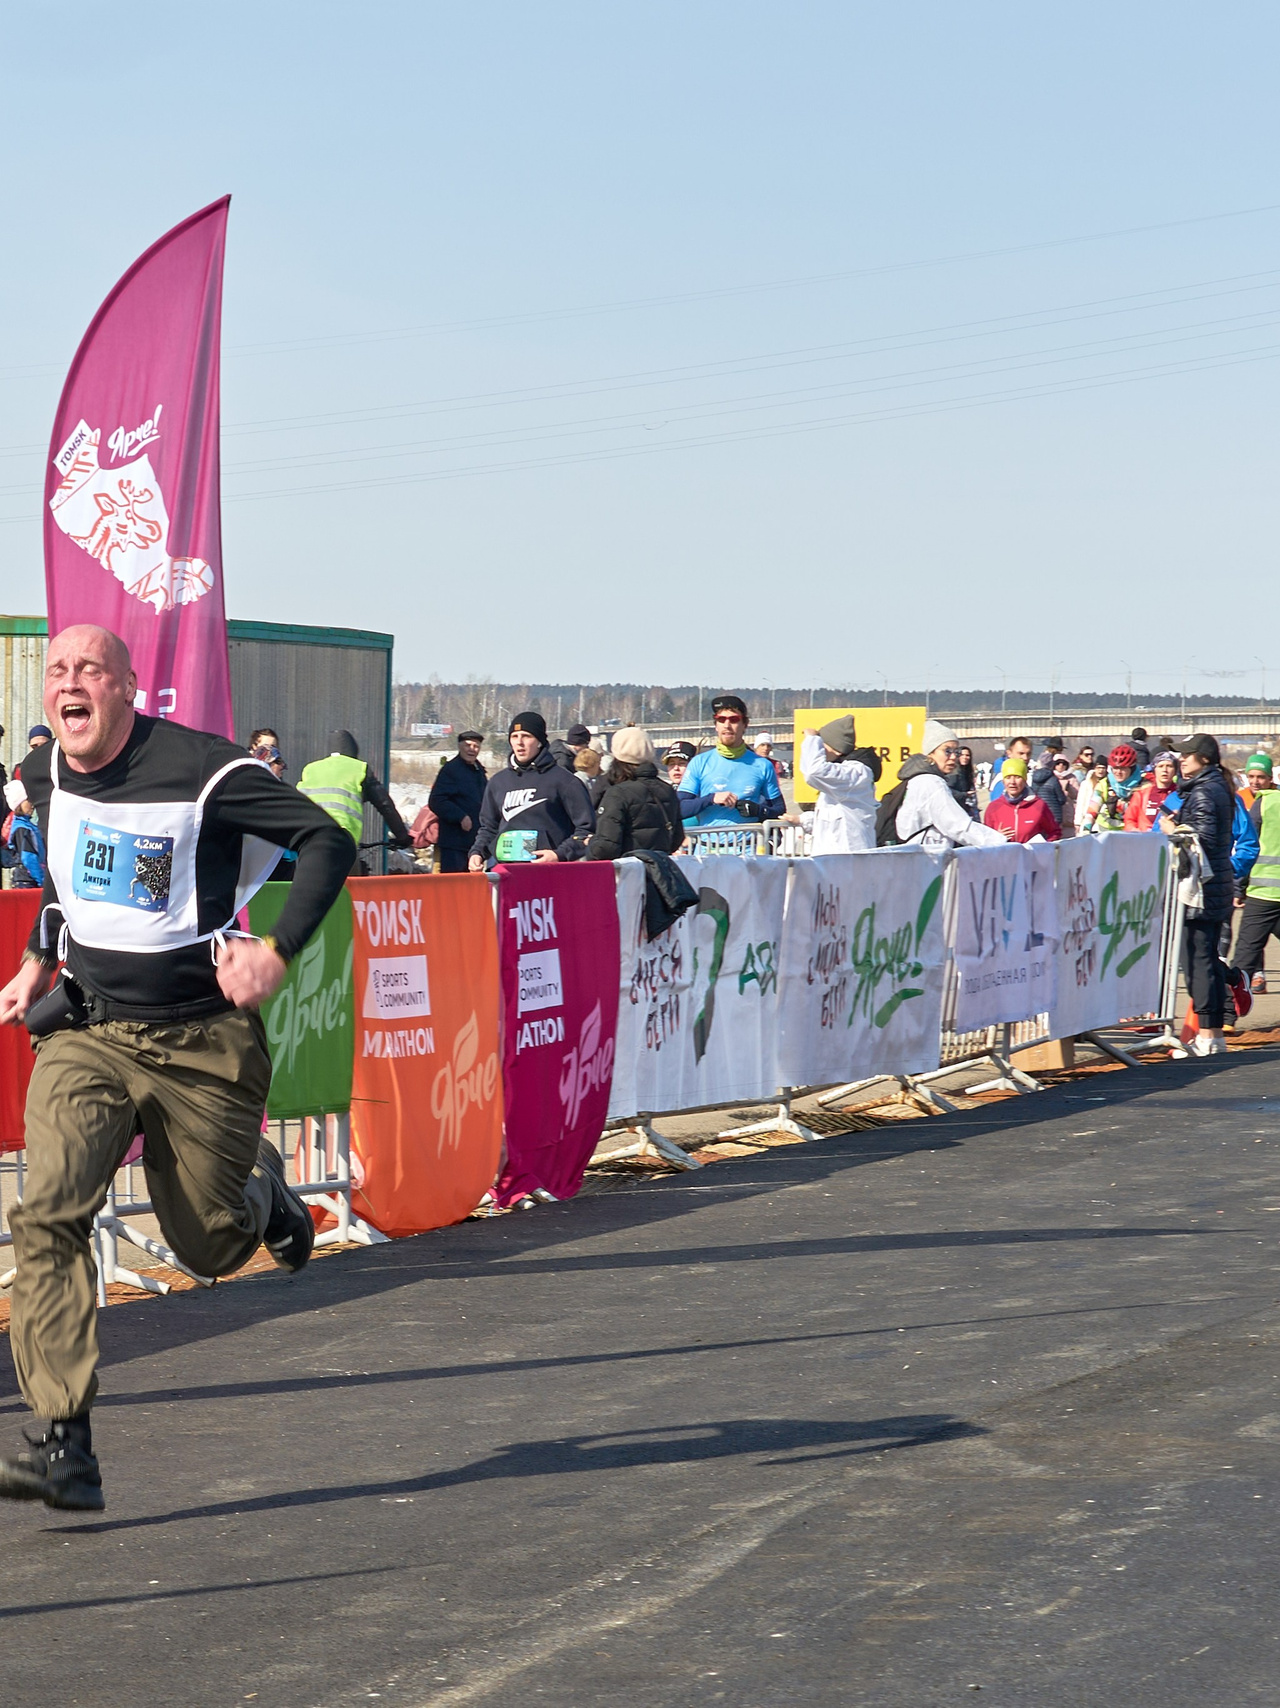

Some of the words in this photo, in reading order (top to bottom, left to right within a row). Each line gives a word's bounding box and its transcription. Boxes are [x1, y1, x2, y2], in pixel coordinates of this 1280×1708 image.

[59, 430, 87, 468] TOMSK
[106, 403, 163, 463] Ярче!
[504, 788, 537, 809] NIKE
[84, 840, 115, 872] 231
[83, 872, 111, 886] Дмитрий
[353, 899, 426, 947] TOMSK
[381, 972, 409, 988] SPORTS
